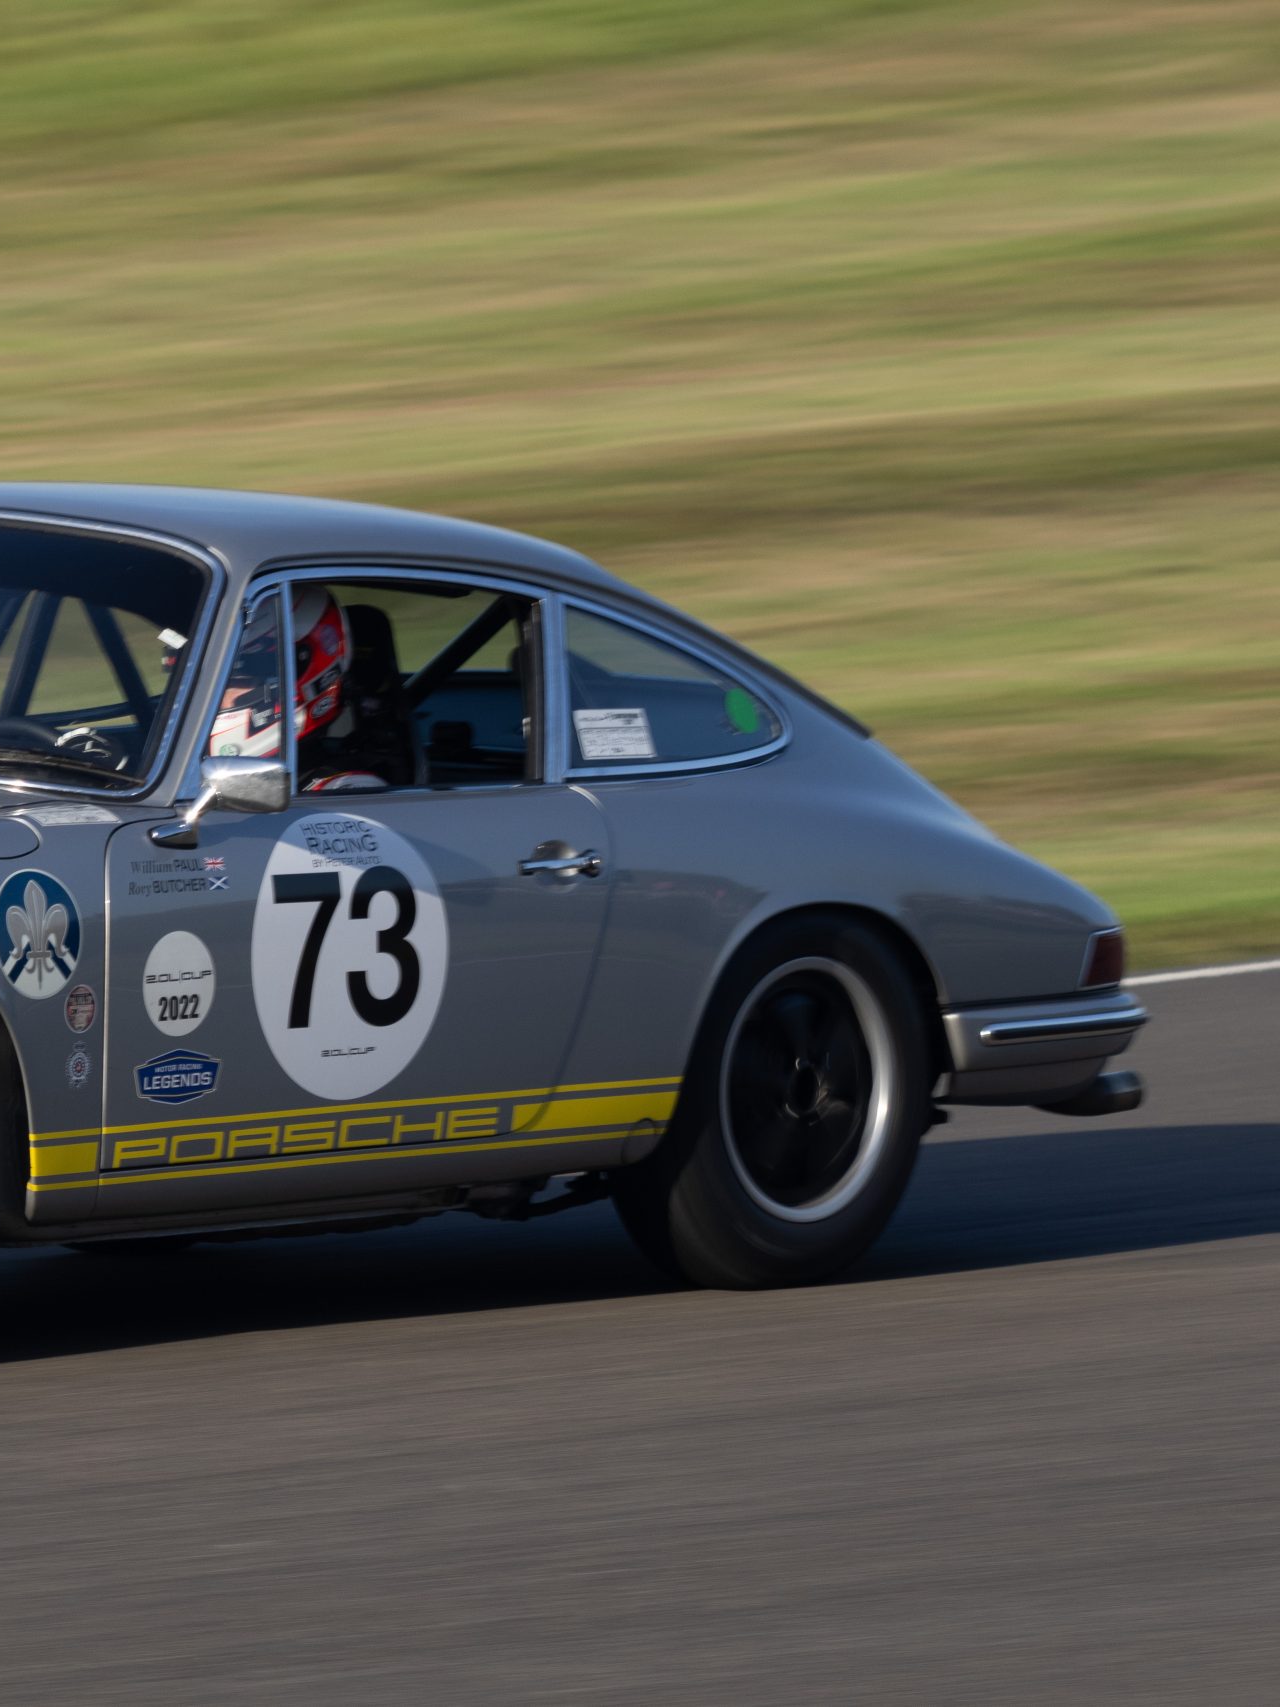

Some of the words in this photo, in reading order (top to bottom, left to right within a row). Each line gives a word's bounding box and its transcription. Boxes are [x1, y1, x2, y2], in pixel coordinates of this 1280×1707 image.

[300, 821, 371, 836] HISTORIC
[305, 834, 379, 854] RACING
[173, 858, 204, 872] PAUL
[128, 881, 151, 897] Rory
[153, 878, 207, 893] BUTCHER
[272, 865, 421, 1029] 73
[158, 994, 200, 1022] 2022
[143, 1071, 213, 1091] LEGENDS
[112, 1106, 500, 1168] PORSCHE
